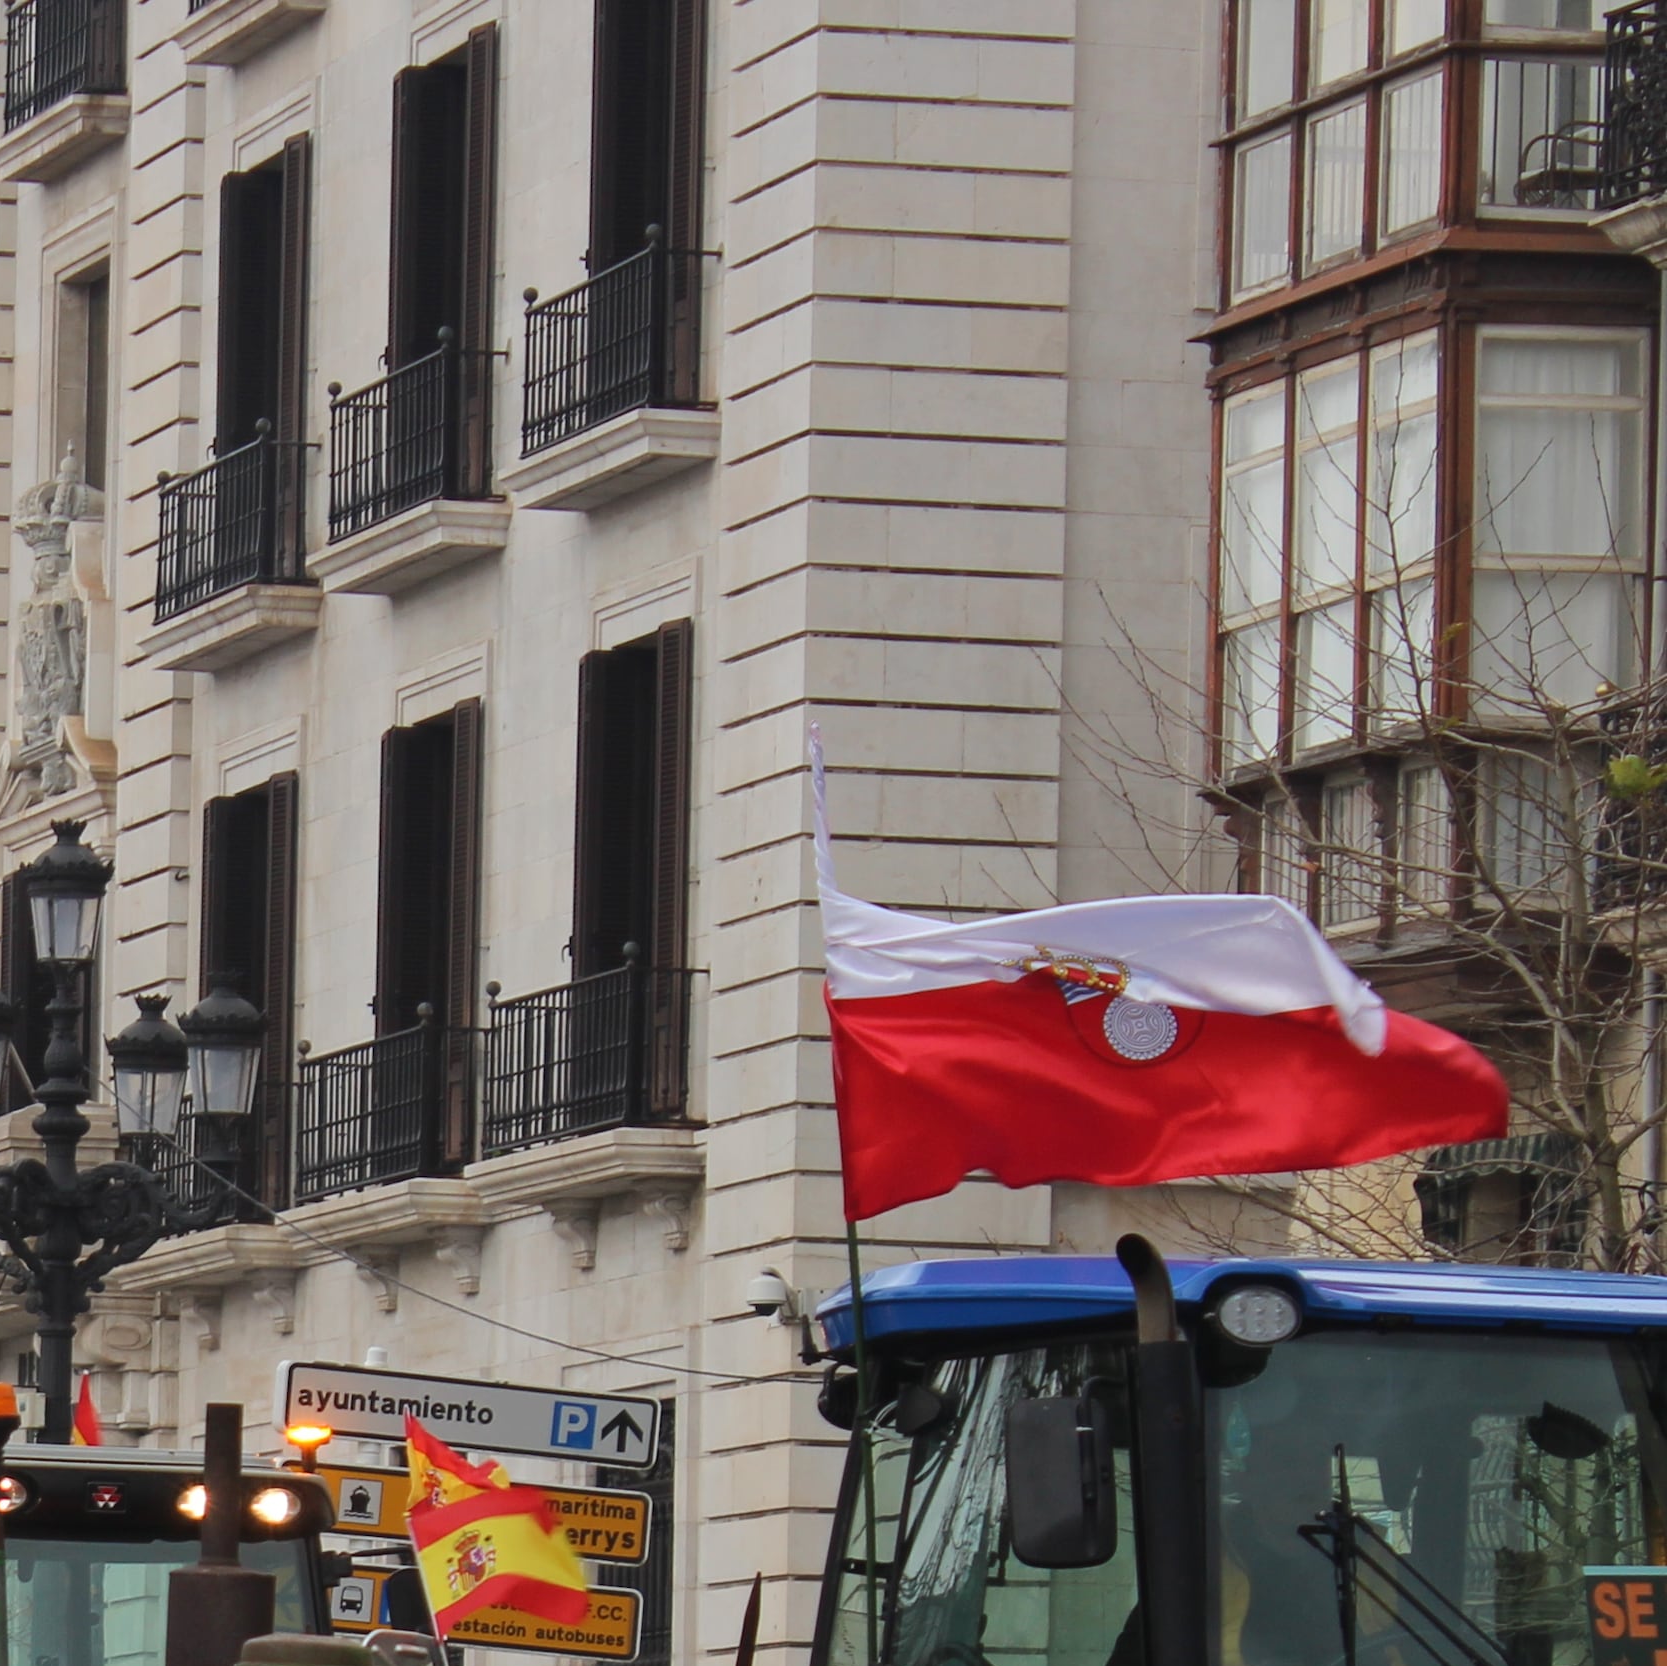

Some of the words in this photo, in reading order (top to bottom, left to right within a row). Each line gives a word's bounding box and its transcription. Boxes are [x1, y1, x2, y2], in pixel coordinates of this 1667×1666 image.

[298, 1386, 493, 1426] ayuntamiento
[557, 1521, 636, 1552] errys
[1593, 1582, 1658, 1638] SE
[452, 1617, 527, 1637] estación
[535, 1625, 625, 1647] autobuses
